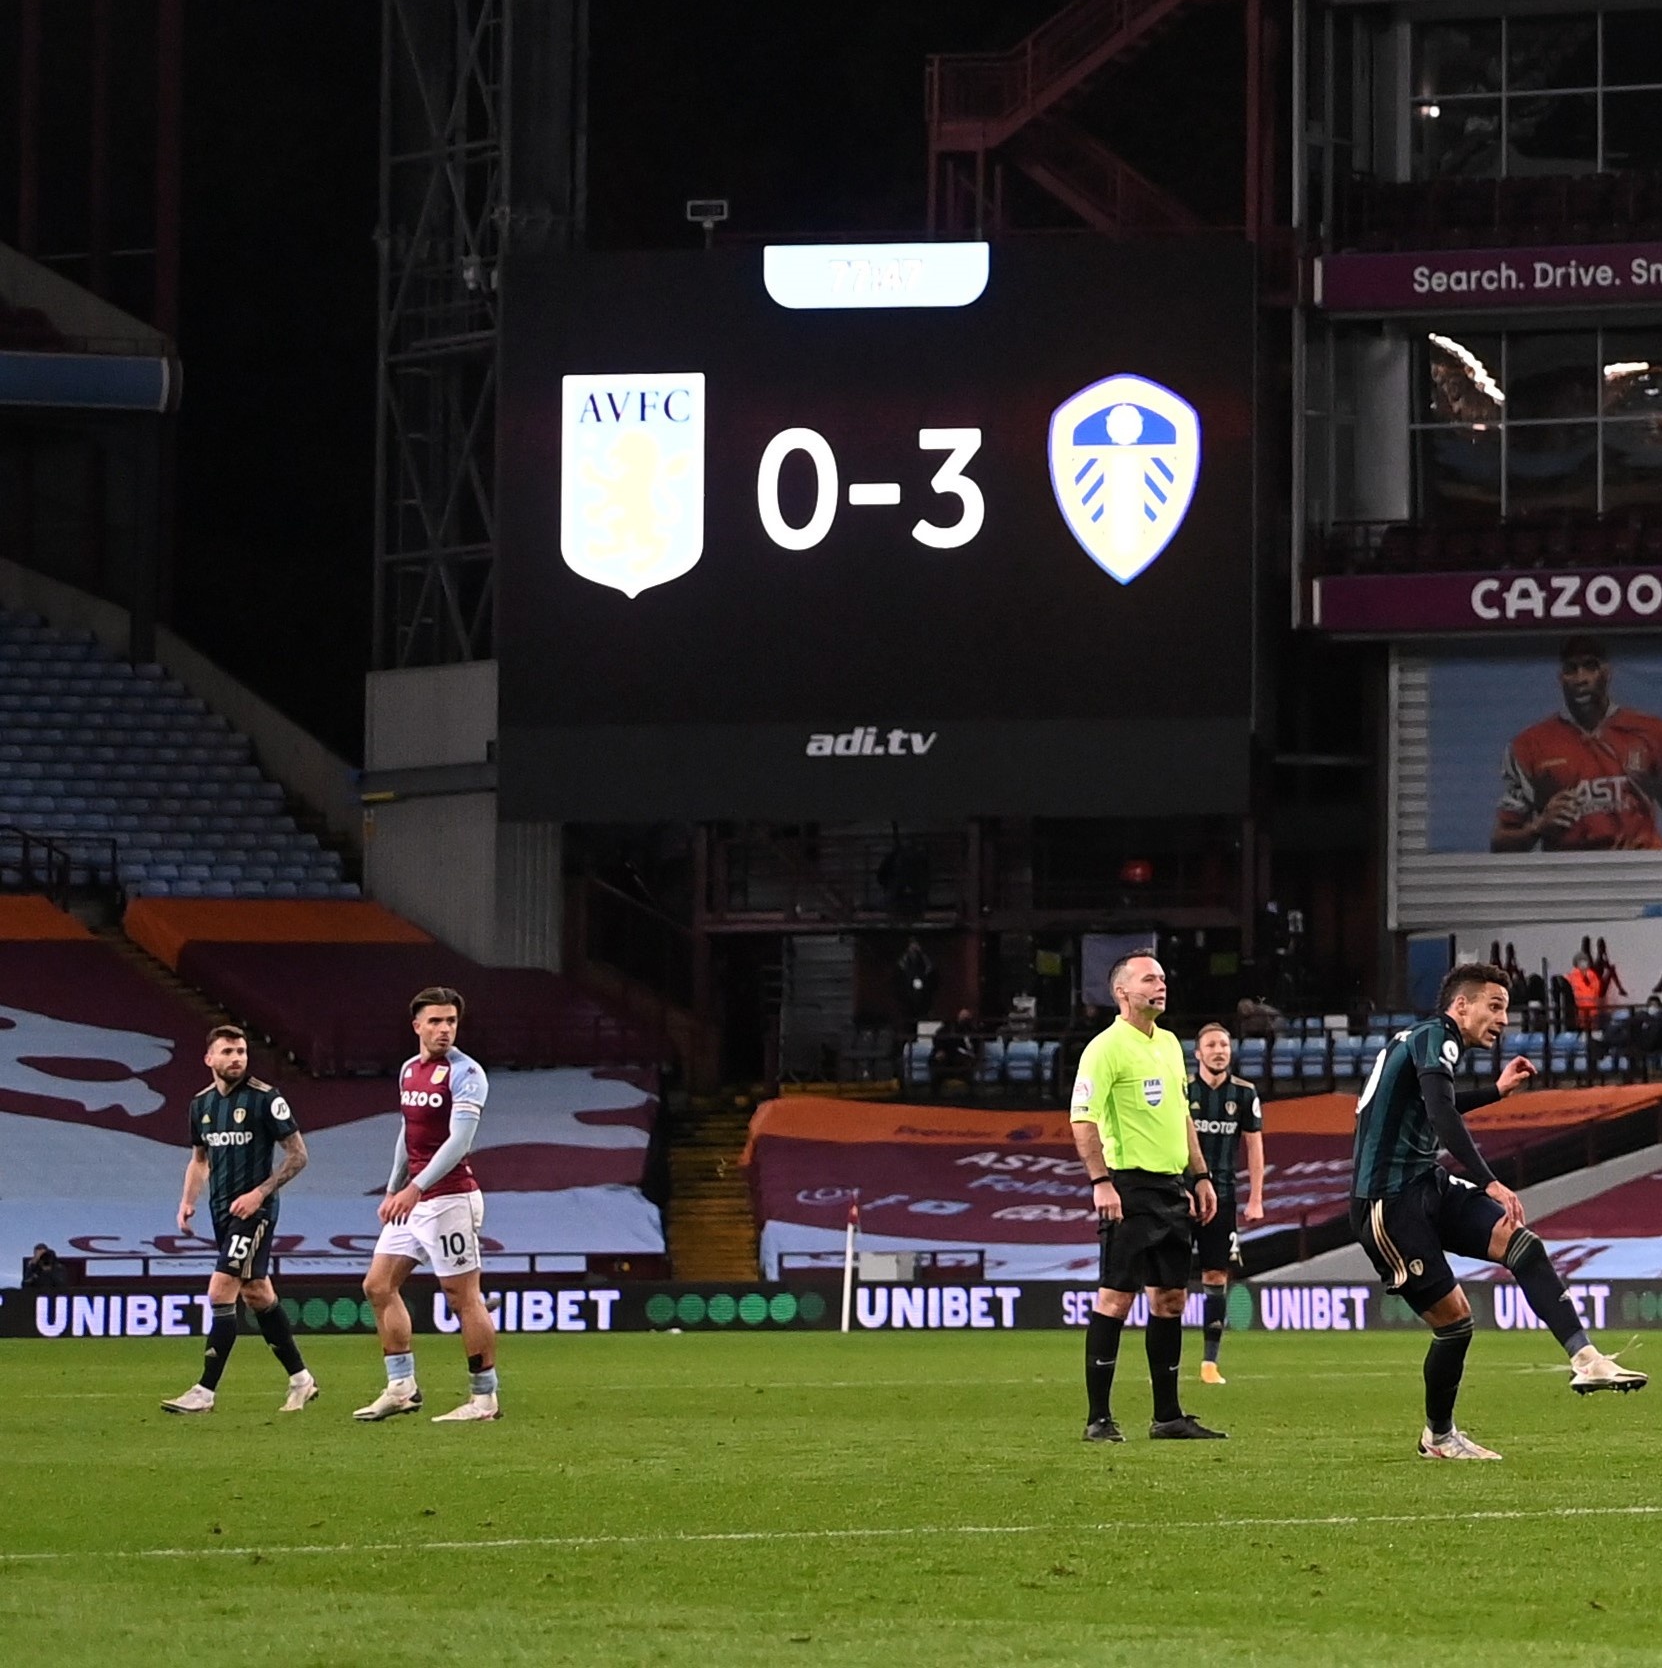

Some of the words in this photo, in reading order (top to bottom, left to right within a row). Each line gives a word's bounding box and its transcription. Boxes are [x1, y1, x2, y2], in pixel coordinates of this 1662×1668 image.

[1413, 263, 1525, 294] Search.
[1533, 259, 1621, 288] Drive.
[579, 389, 691, 423] AVFC
[757, 427, 986, 551] 0-3
[805, 728, 938, 758] adi.tv
[206, 1131, 253, 1147] SBOTOP
[228, 1235, 251, 1260] 15
[440, 1233, 466, 1258] 10
[856, 1286, 1021, 1329] UNIBET
[1261, 1286, 1370, 1330] UNIBET
